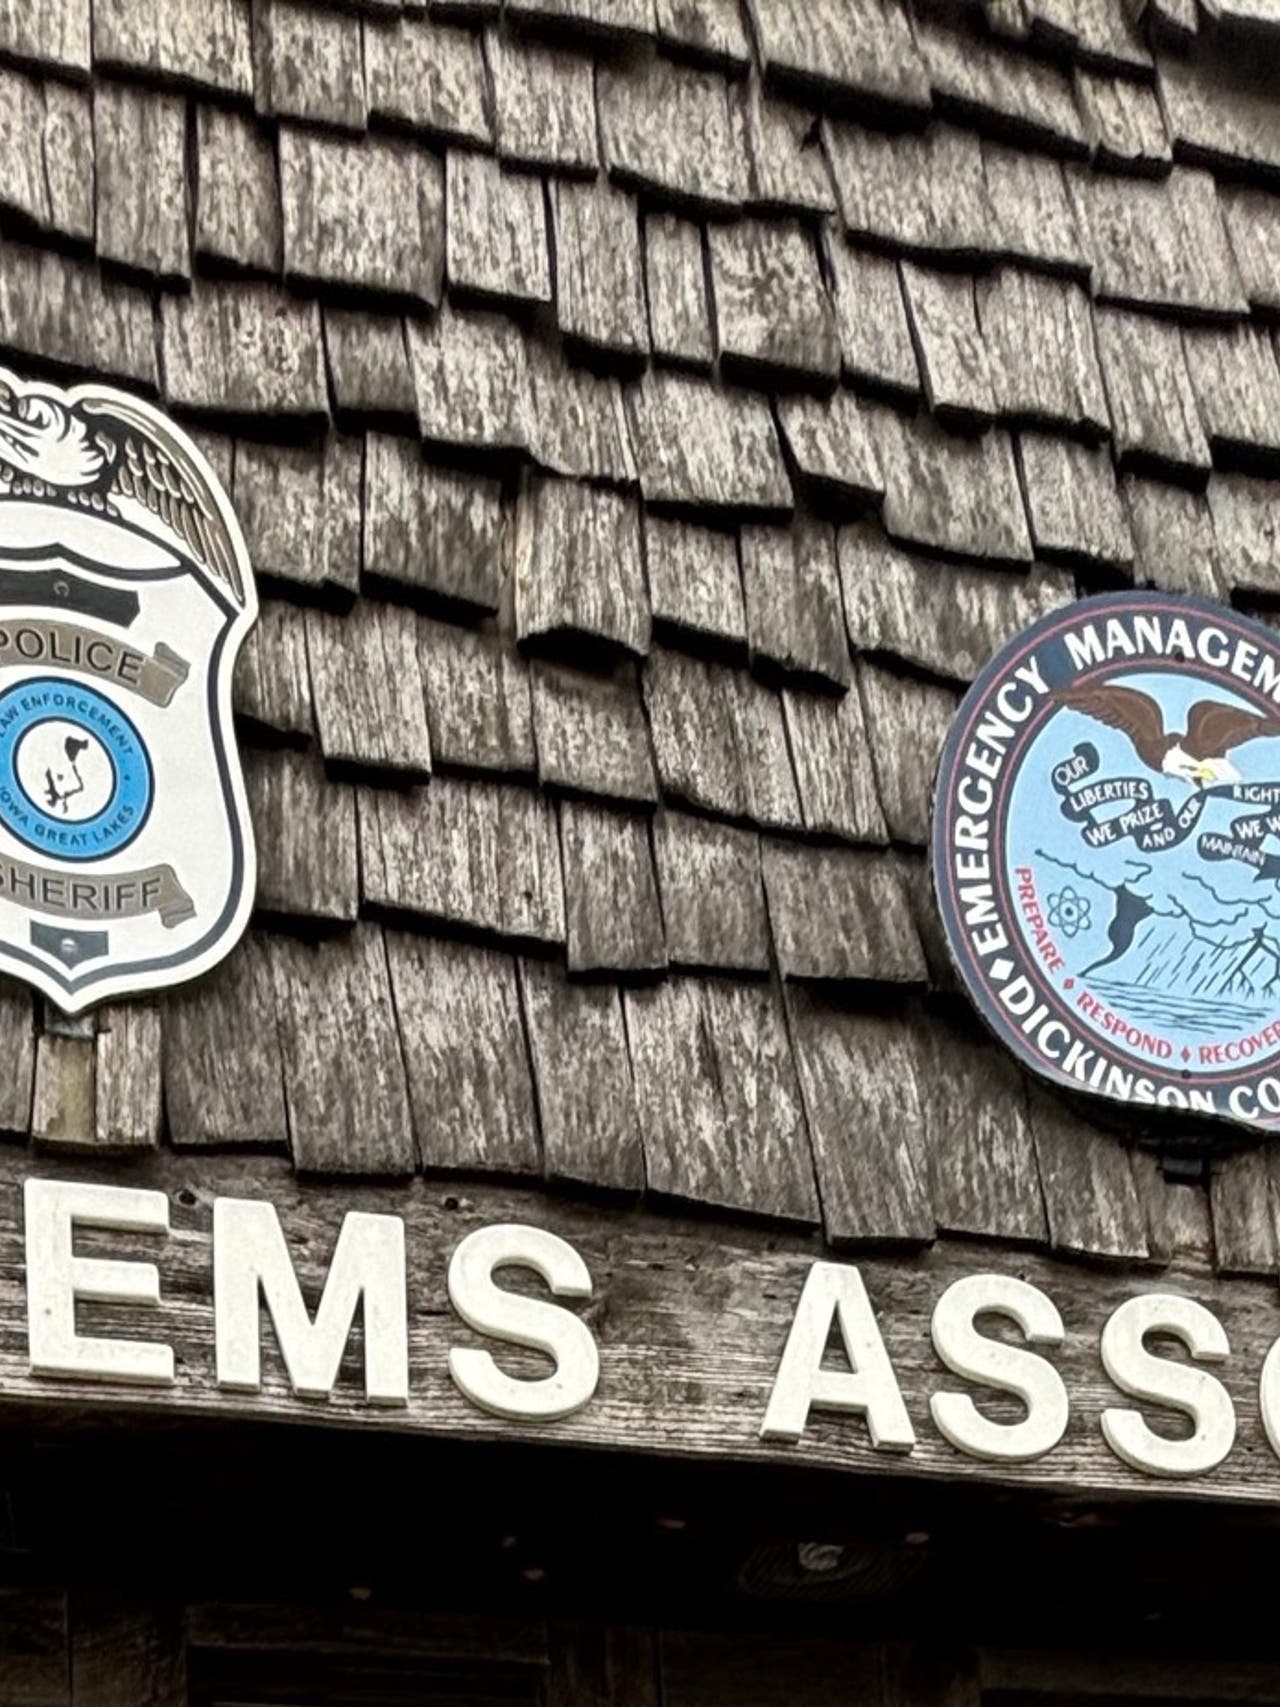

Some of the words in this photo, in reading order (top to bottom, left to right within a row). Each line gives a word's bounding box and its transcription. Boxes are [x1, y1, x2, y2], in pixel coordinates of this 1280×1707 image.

[20, 692, 134, 755] ENFORCEMENT
[1054, 755, 1089, 786] OUR
[954, 655, 1051, 957] EMERGENCY
[1070, 781, 1149, 813] LIBERTIES
[1142, 828, 1176, 849] AND
[1178, 797, 1202, 829] OUR
[34, 822, 88, 846] GREAT
[93, 804, 135, 843] LAKES
[1086, 824, 1117, 846] WE
[1119, 802, 1165, 834] PRIZE
[1235, 820, 1265, 840] WE
[1015, 867, 1065, 975] PREPARE
[1076, 991, 1171, 1059] RESPOND
[998, 976, 1217, 1113] DICKINSON
[23, 1178, 602, 1424] EMS
